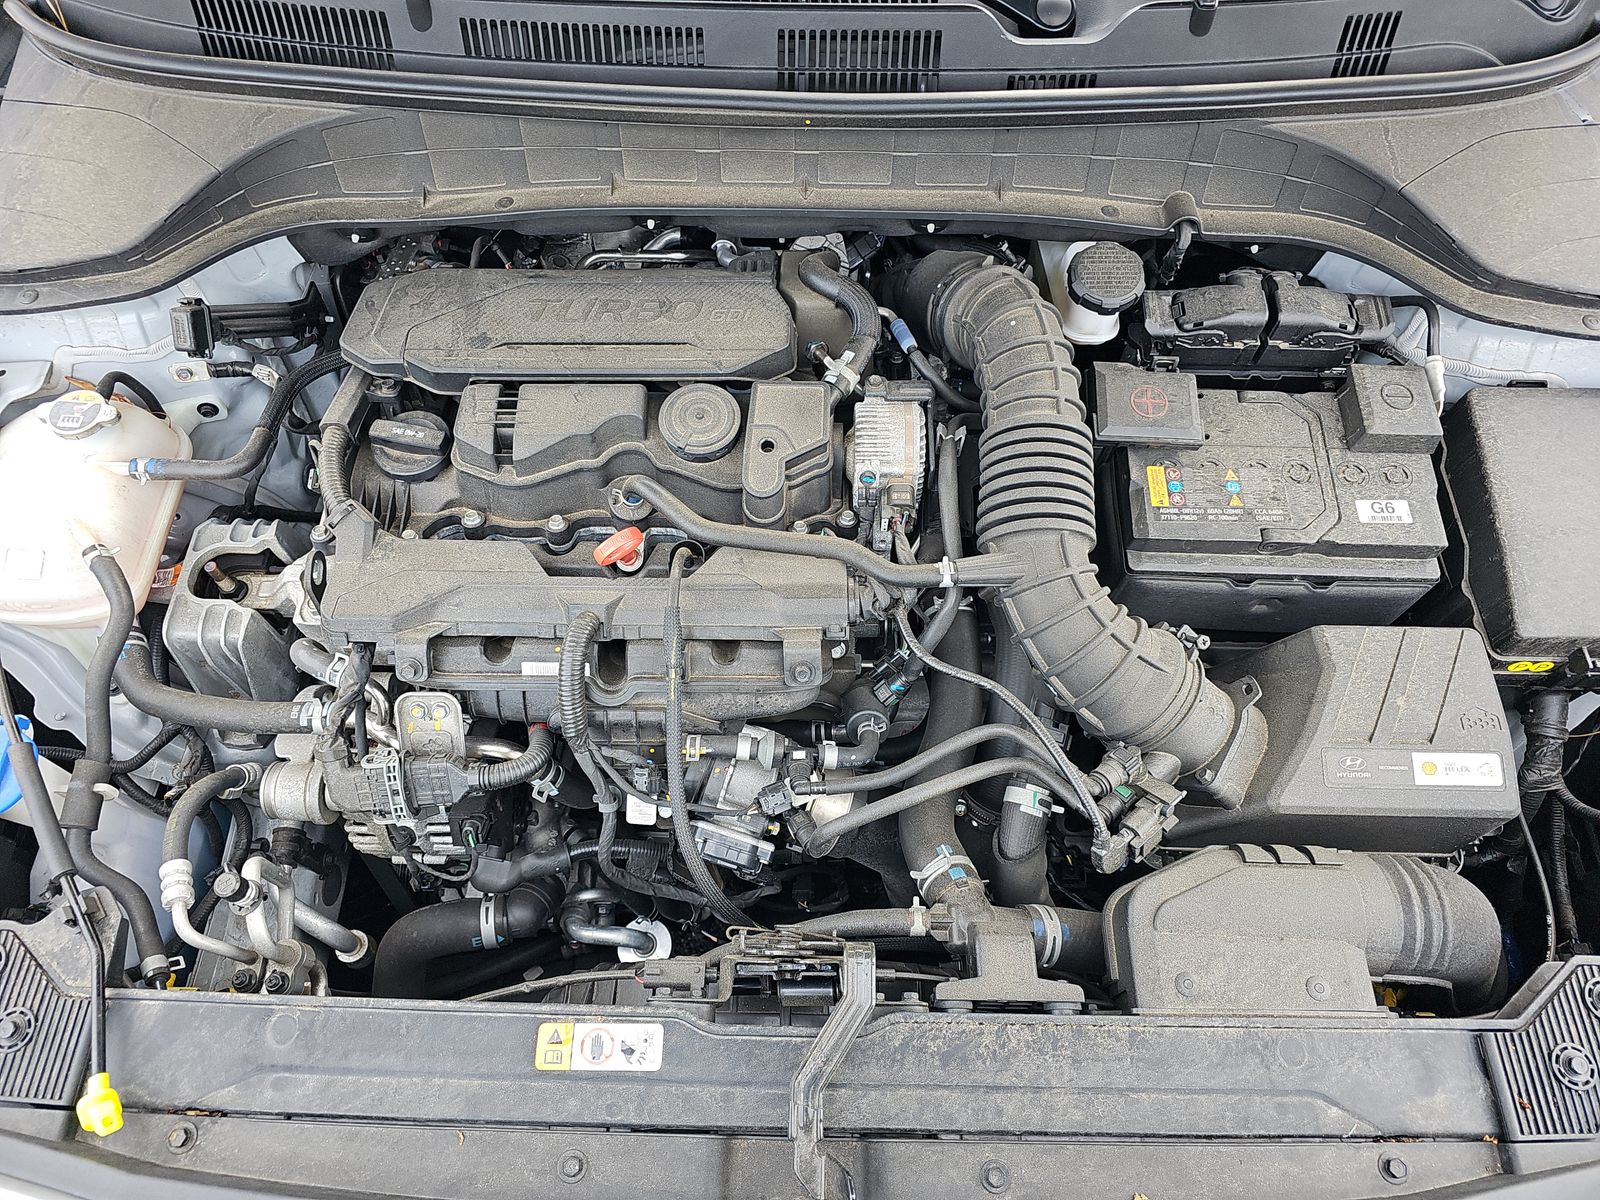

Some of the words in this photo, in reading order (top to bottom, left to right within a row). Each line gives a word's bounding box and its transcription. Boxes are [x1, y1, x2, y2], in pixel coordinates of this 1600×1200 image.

[527, 299, 703, 323] TURBO
[709, 309, 752, 322] GDI
[392, 427, 404, 435] SAE
[404, 429, 425, 439] 0W-20
[1370, 501, 1395, 514] G6
